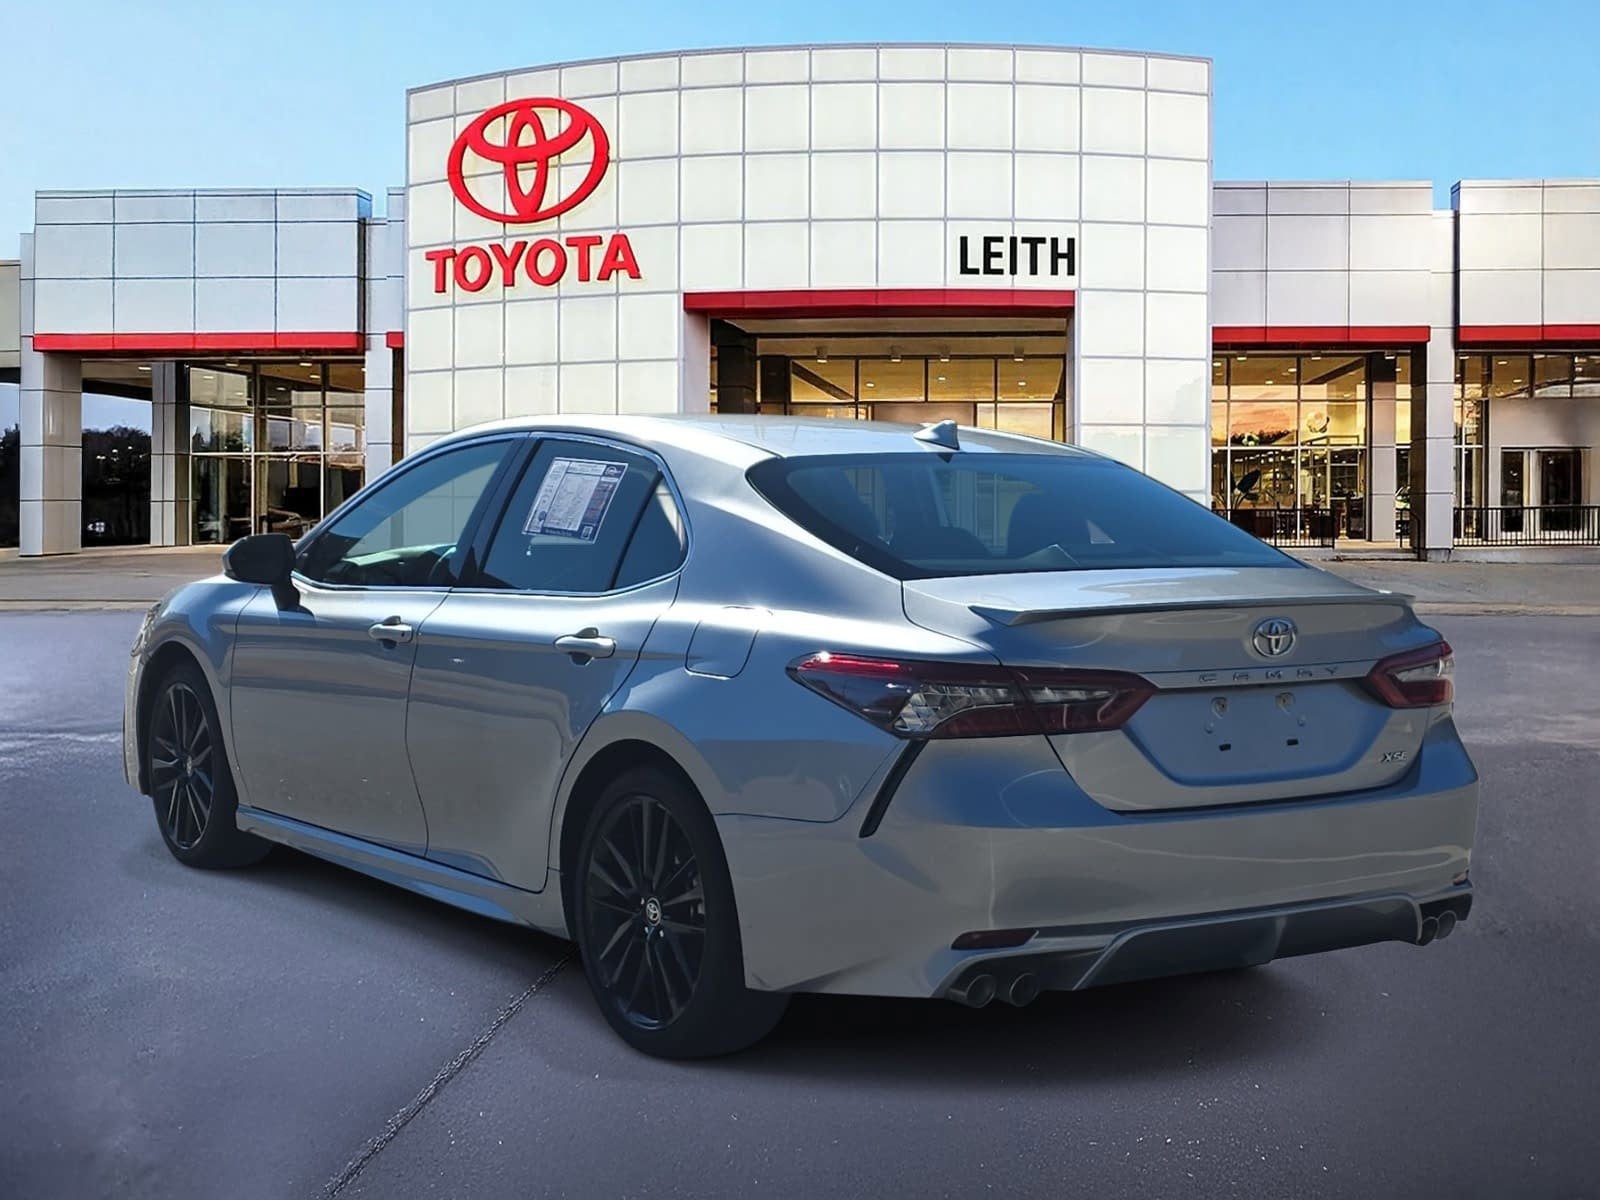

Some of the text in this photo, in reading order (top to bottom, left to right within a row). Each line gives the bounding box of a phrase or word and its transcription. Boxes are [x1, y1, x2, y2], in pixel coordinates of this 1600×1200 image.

[425, 234, 642, 293] TOYOTA
[960, 236, 1075, 275] LEITH
[1199, 666, 1338, 682] CAMRY
[1381, 751, 1408, 763] XSE
